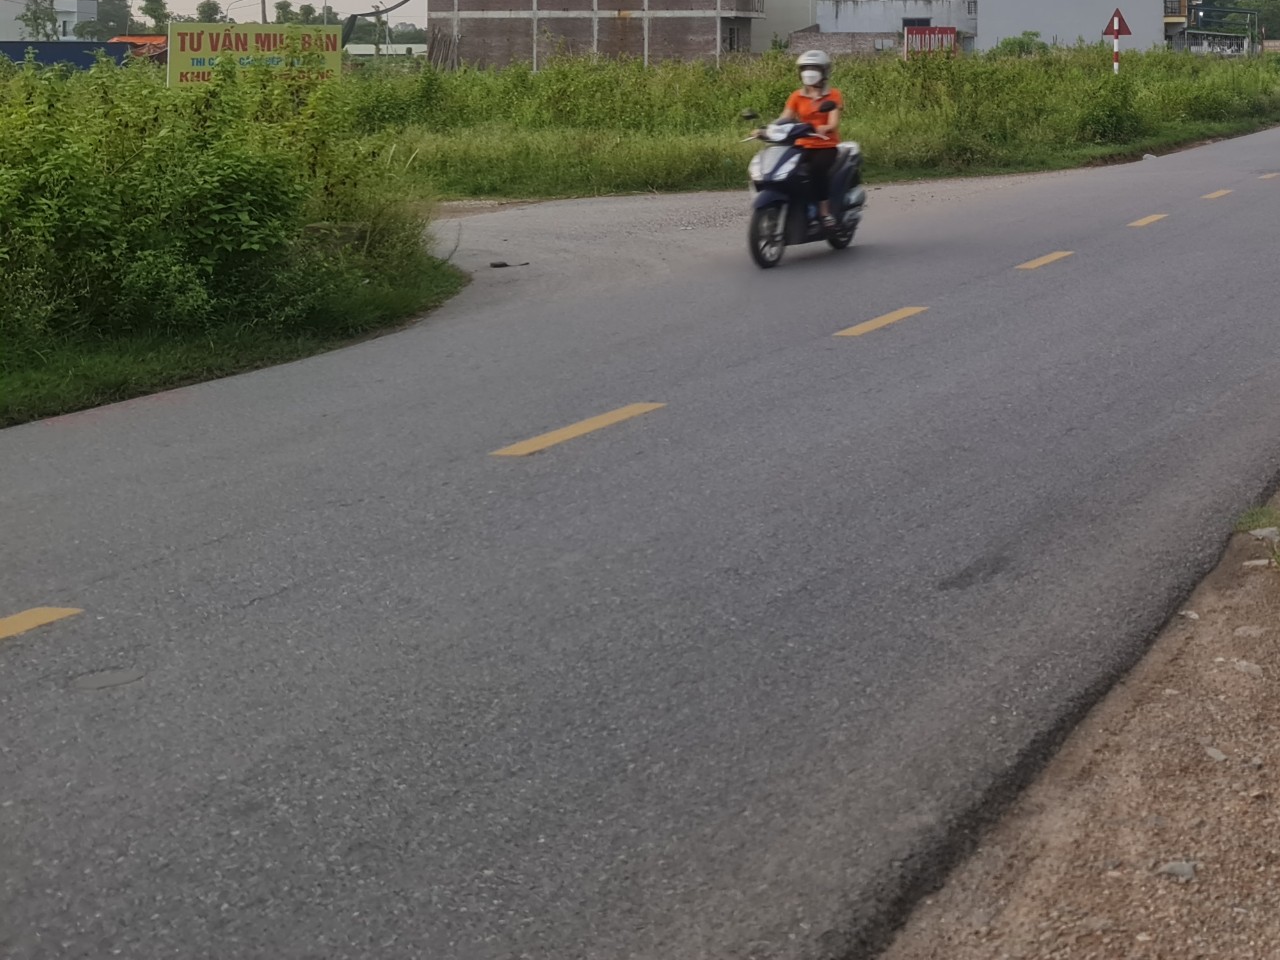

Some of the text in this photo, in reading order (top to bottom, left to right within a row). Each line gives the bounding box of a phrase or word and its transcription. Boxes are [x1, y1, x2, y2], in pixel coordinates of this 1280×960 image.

[177, 30, 205, 52] TƯ
[208, 25, 249, 52] VẤN
[254, 32, 291, 52] MU
